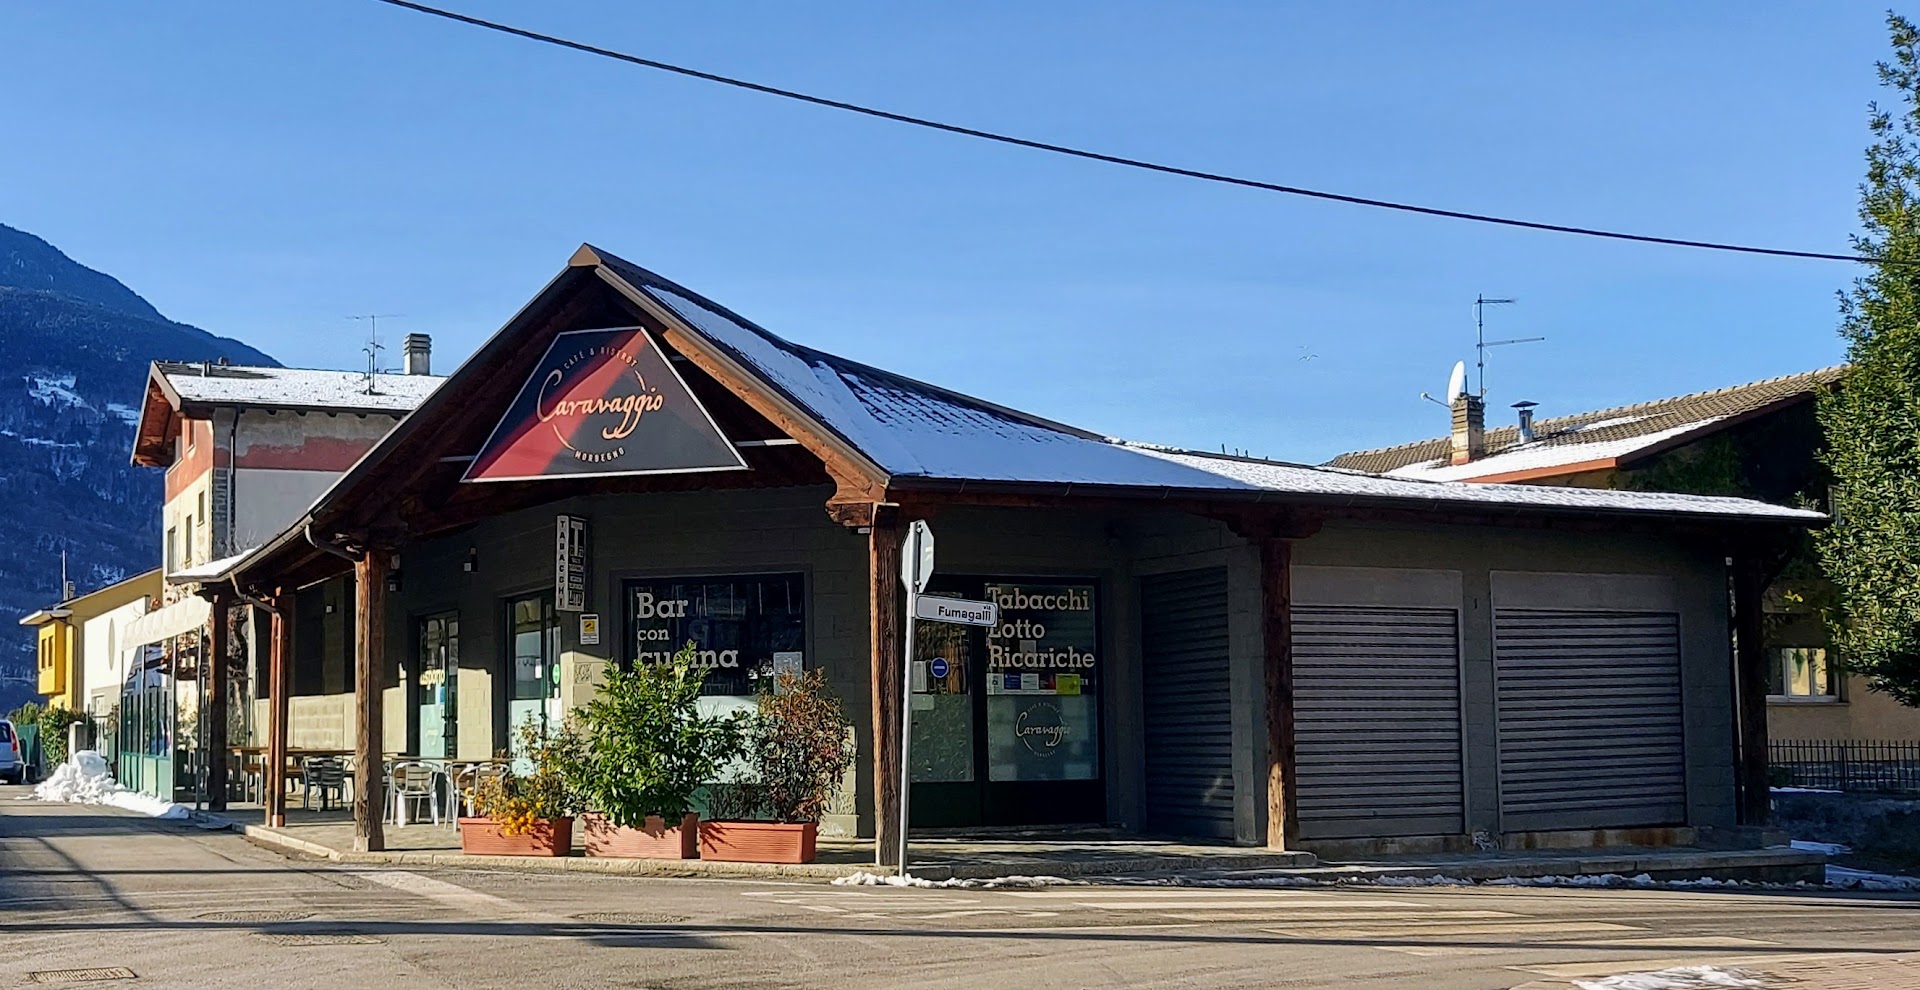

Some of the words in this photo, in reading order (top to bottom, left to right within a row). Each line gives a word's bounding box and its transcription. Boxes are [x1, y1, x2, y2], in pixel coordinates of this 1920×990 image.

[600, 346, 638, 367] BISTROT
[537, 369, 664, 440] Caravaggio
[636, 592, 688, 618] Bar
[987, 586, 1089, 610] Tabacchi
[938, 605, 991, 622] Fumagalli
[637, 628, 670, 641] con
[988, 619, 1045, 638] Lotto
[988, 645, 1095, 668] Ricariche
